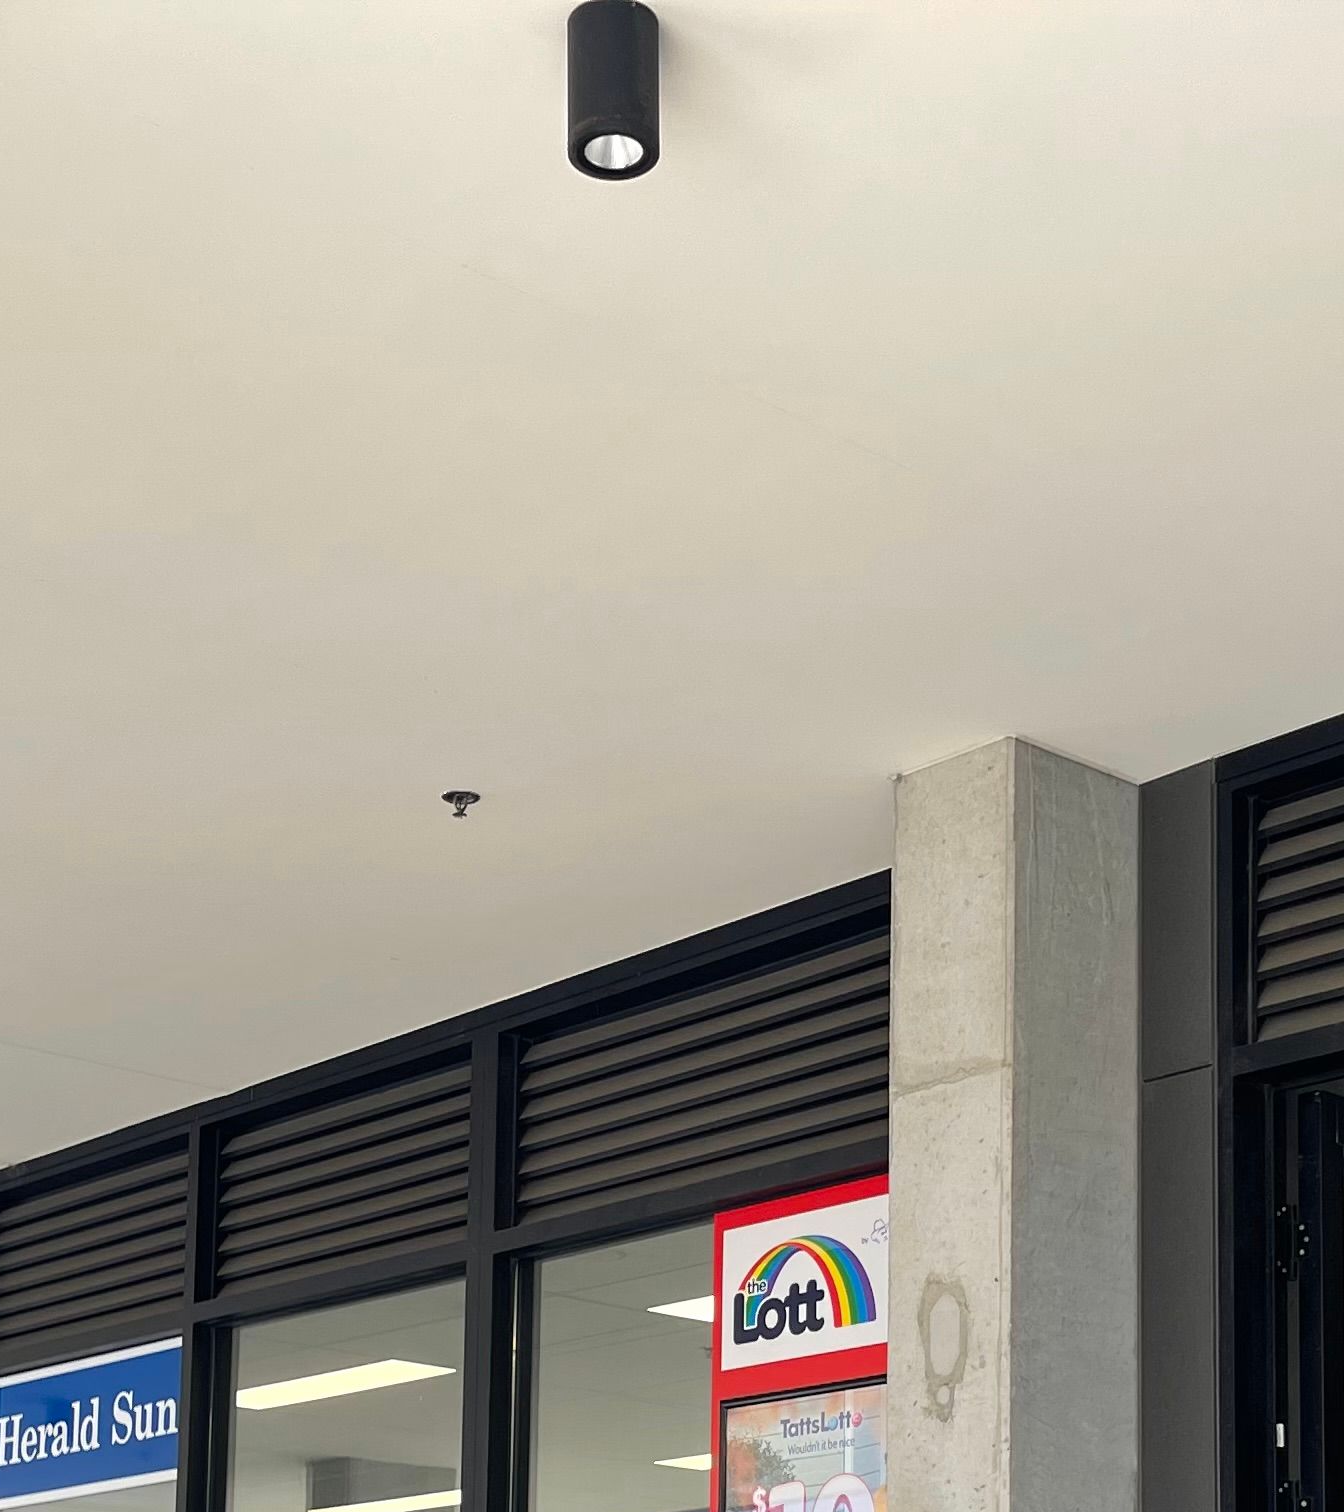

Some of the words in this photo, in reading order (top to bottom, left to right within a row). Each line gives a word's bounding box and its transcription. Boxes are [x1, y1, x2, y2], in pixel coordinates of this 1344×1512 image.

[747, 1279, 767, 1293] the
[733, 1279, 825, 1345] Lott
[111, 1390, 178, 1445] Sun
[780, 1411, 863, 1439] TattsLotto
[787, 1440, 821, 1456] Wouldn't
[828, 1438, 838, 1449] be
[839, 1436, 856, 1448] nice
